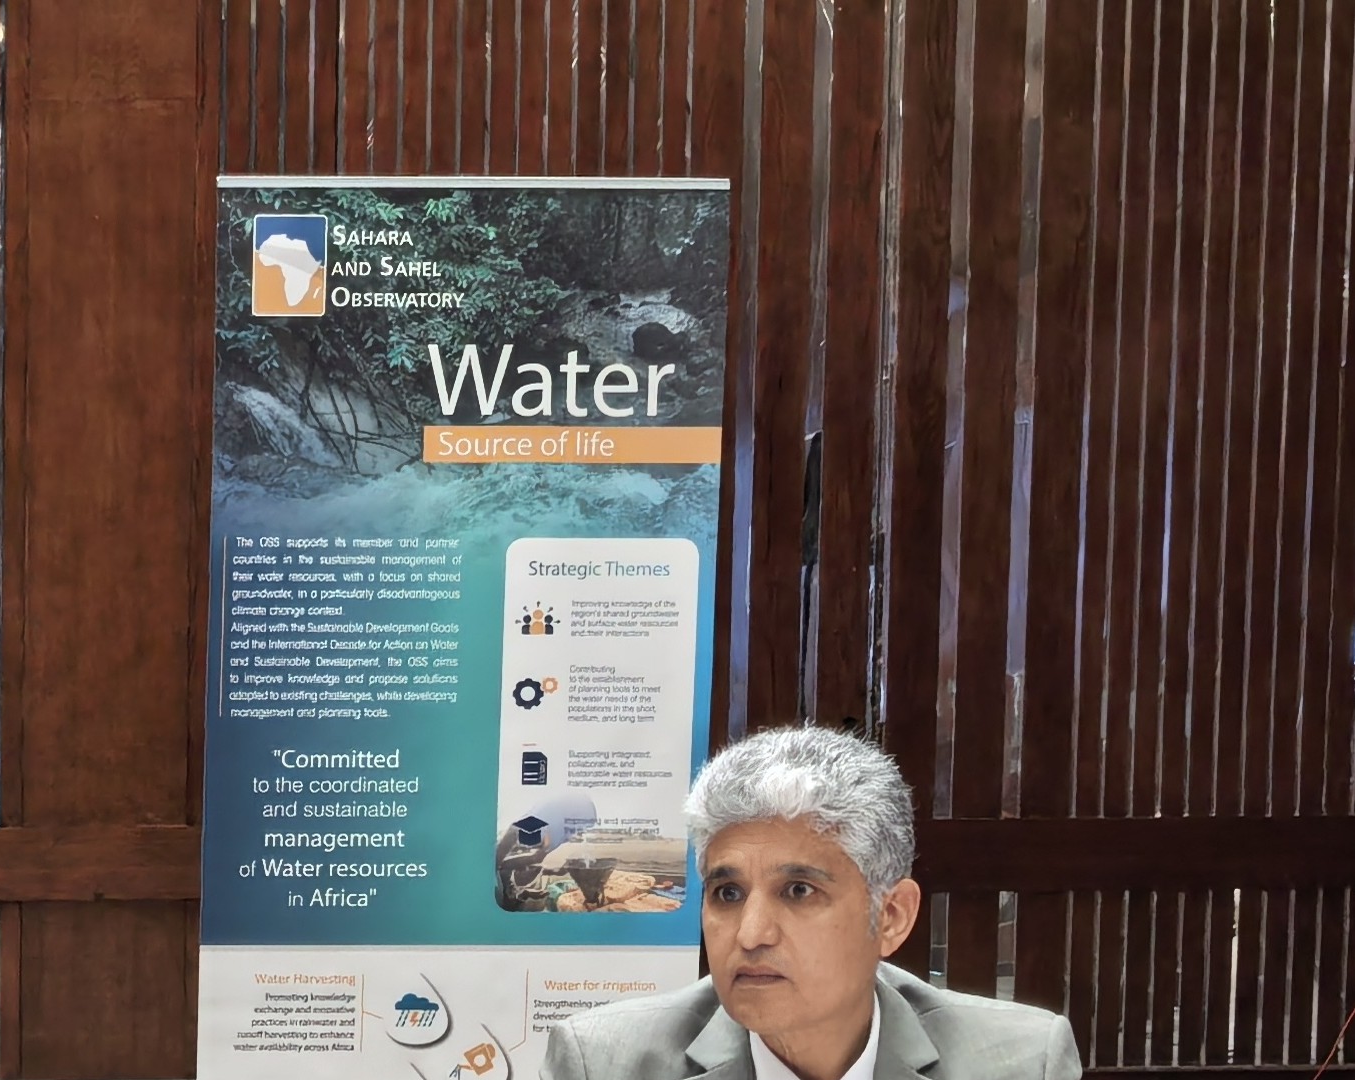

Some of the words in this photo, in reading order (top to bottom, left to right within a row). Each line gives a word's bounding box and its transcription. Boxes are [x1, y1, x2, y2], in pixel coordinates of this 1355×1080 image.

[427, 343, 676, 418] Water
[438, 433, 532, 457] Source
[540, 431, 567, 457] of
[575, 431, 615, 457] life
[233, 555, 276, 566] countries
[382, 555, 446, 566] management
[528, 561, 602, 580] Strategic
[605, 561, 670, 576] Themes
[274, 749, 399, 769] "Committed
[253, 779, 269, 793] to
[276, 777, 303, 793] the
[309, 777, 419, 793] coordinated
[263, 802, 296, 817] and
[304, 802, 407, 817] sustainable
[264, 830, 405, 852] management
[239, 861, 256, 877] of
[262, 859, 323, 877] Water
[329, 862, 427, 877] resources
[289, 892, 303, 907] in
[309, 889, 377, 907] Africa"
[255, 974, 290, 984] Water
[294, 974, 356, 986] Harvesting
[545, 981, 581, 991] Water
[584, 980, 600, 990] for
[603, 980, 656, 992] irrigation
